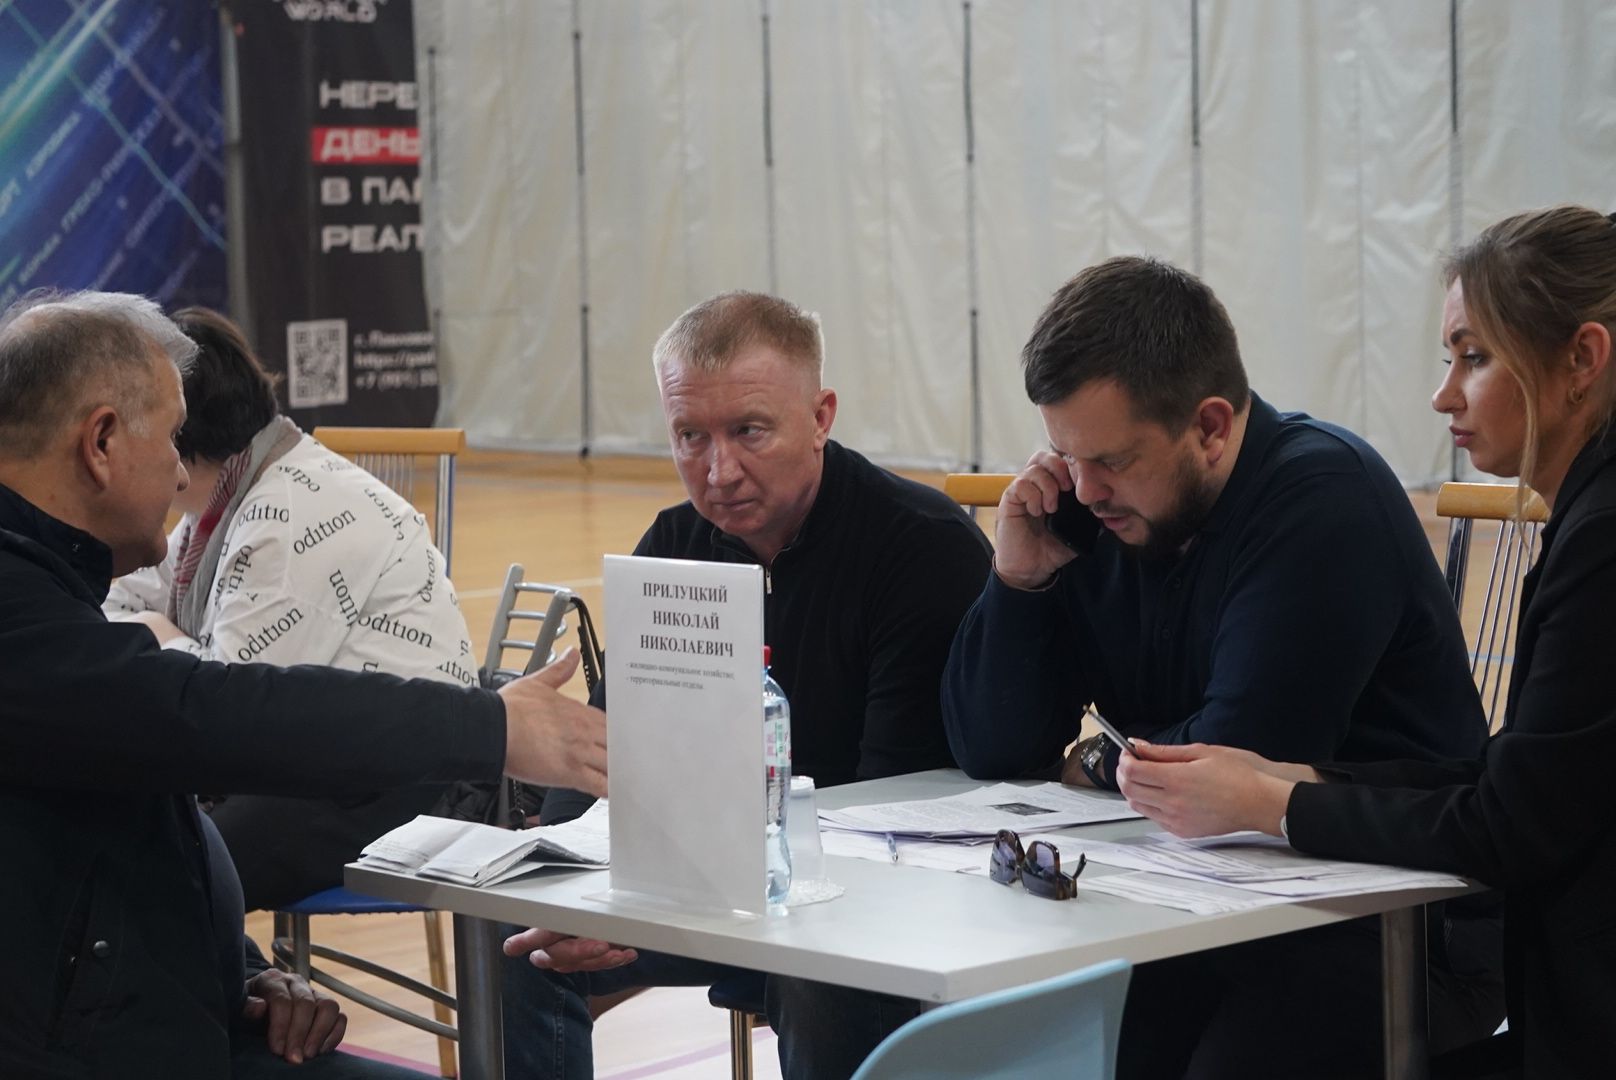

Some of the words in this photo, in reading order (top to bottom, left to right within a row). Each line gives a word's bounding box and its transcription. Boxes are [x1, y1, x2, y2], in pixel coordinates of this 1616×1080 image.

[321, 177, 349, 204] В
[293, 509, 357, 555] odition
[642, 582, 728, 603] ПРИЛУЦКИЙ
[653, 610, 720, 630] НИКОЛАЙ
[237, 606, 304, 662] odition
[640, 634, 734, 657] НИКОЛАЕВИЧ
